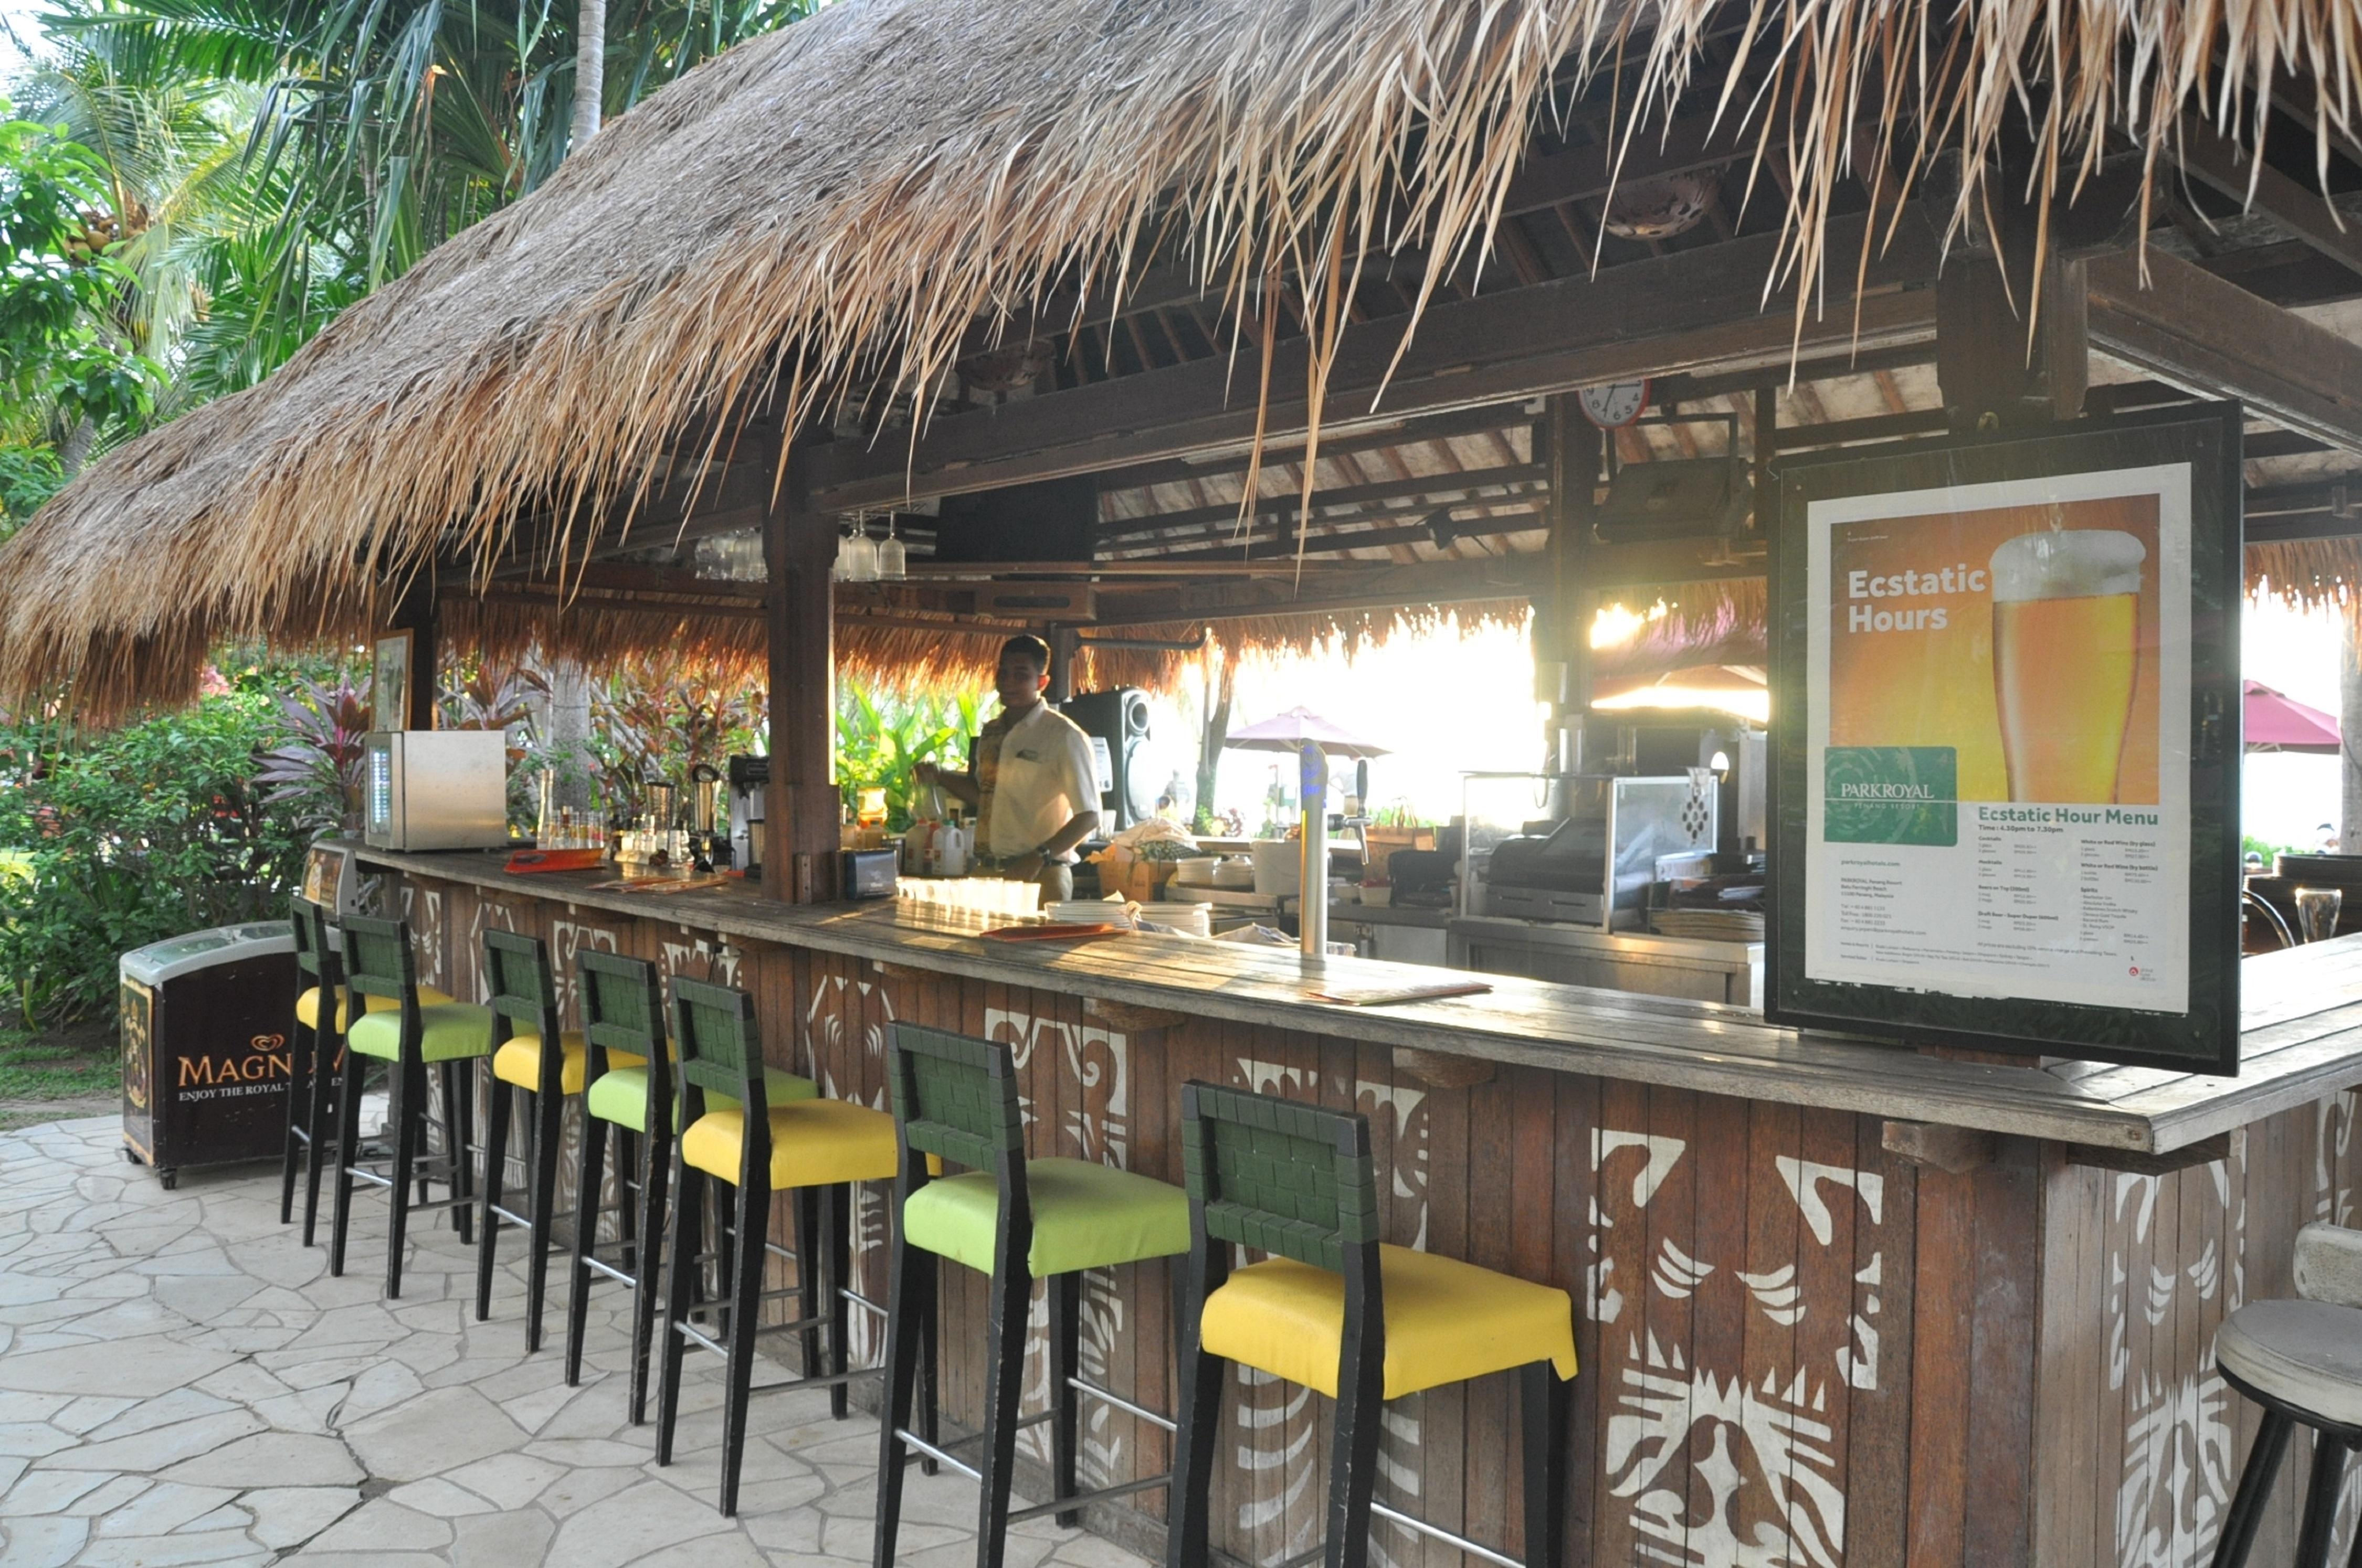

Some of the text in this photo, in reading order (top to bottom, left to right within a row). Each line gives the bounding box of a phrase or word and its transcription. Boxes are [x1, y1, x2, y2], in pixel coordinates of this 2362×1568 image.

[1592, 399, 1600, 409] 8
[1632, 393, 1639, 401] 4
[1614, 410, 1621, 420] 6
[1625, 405, 1632, 414] 5
[1849, 563, 1986, 598] Ecstatic
[1849, 605, 1948, 633] Hours
[1841, 782, 1935, 799] PARKROYAL
[1978, 806, 2159, 825] Ecstatic Hour Menu
[179, 1089, 216, 1101] ENJOY
[220, 1086, 244, 1097] THE
[246, 1083, 284, 1095] ROYAL
